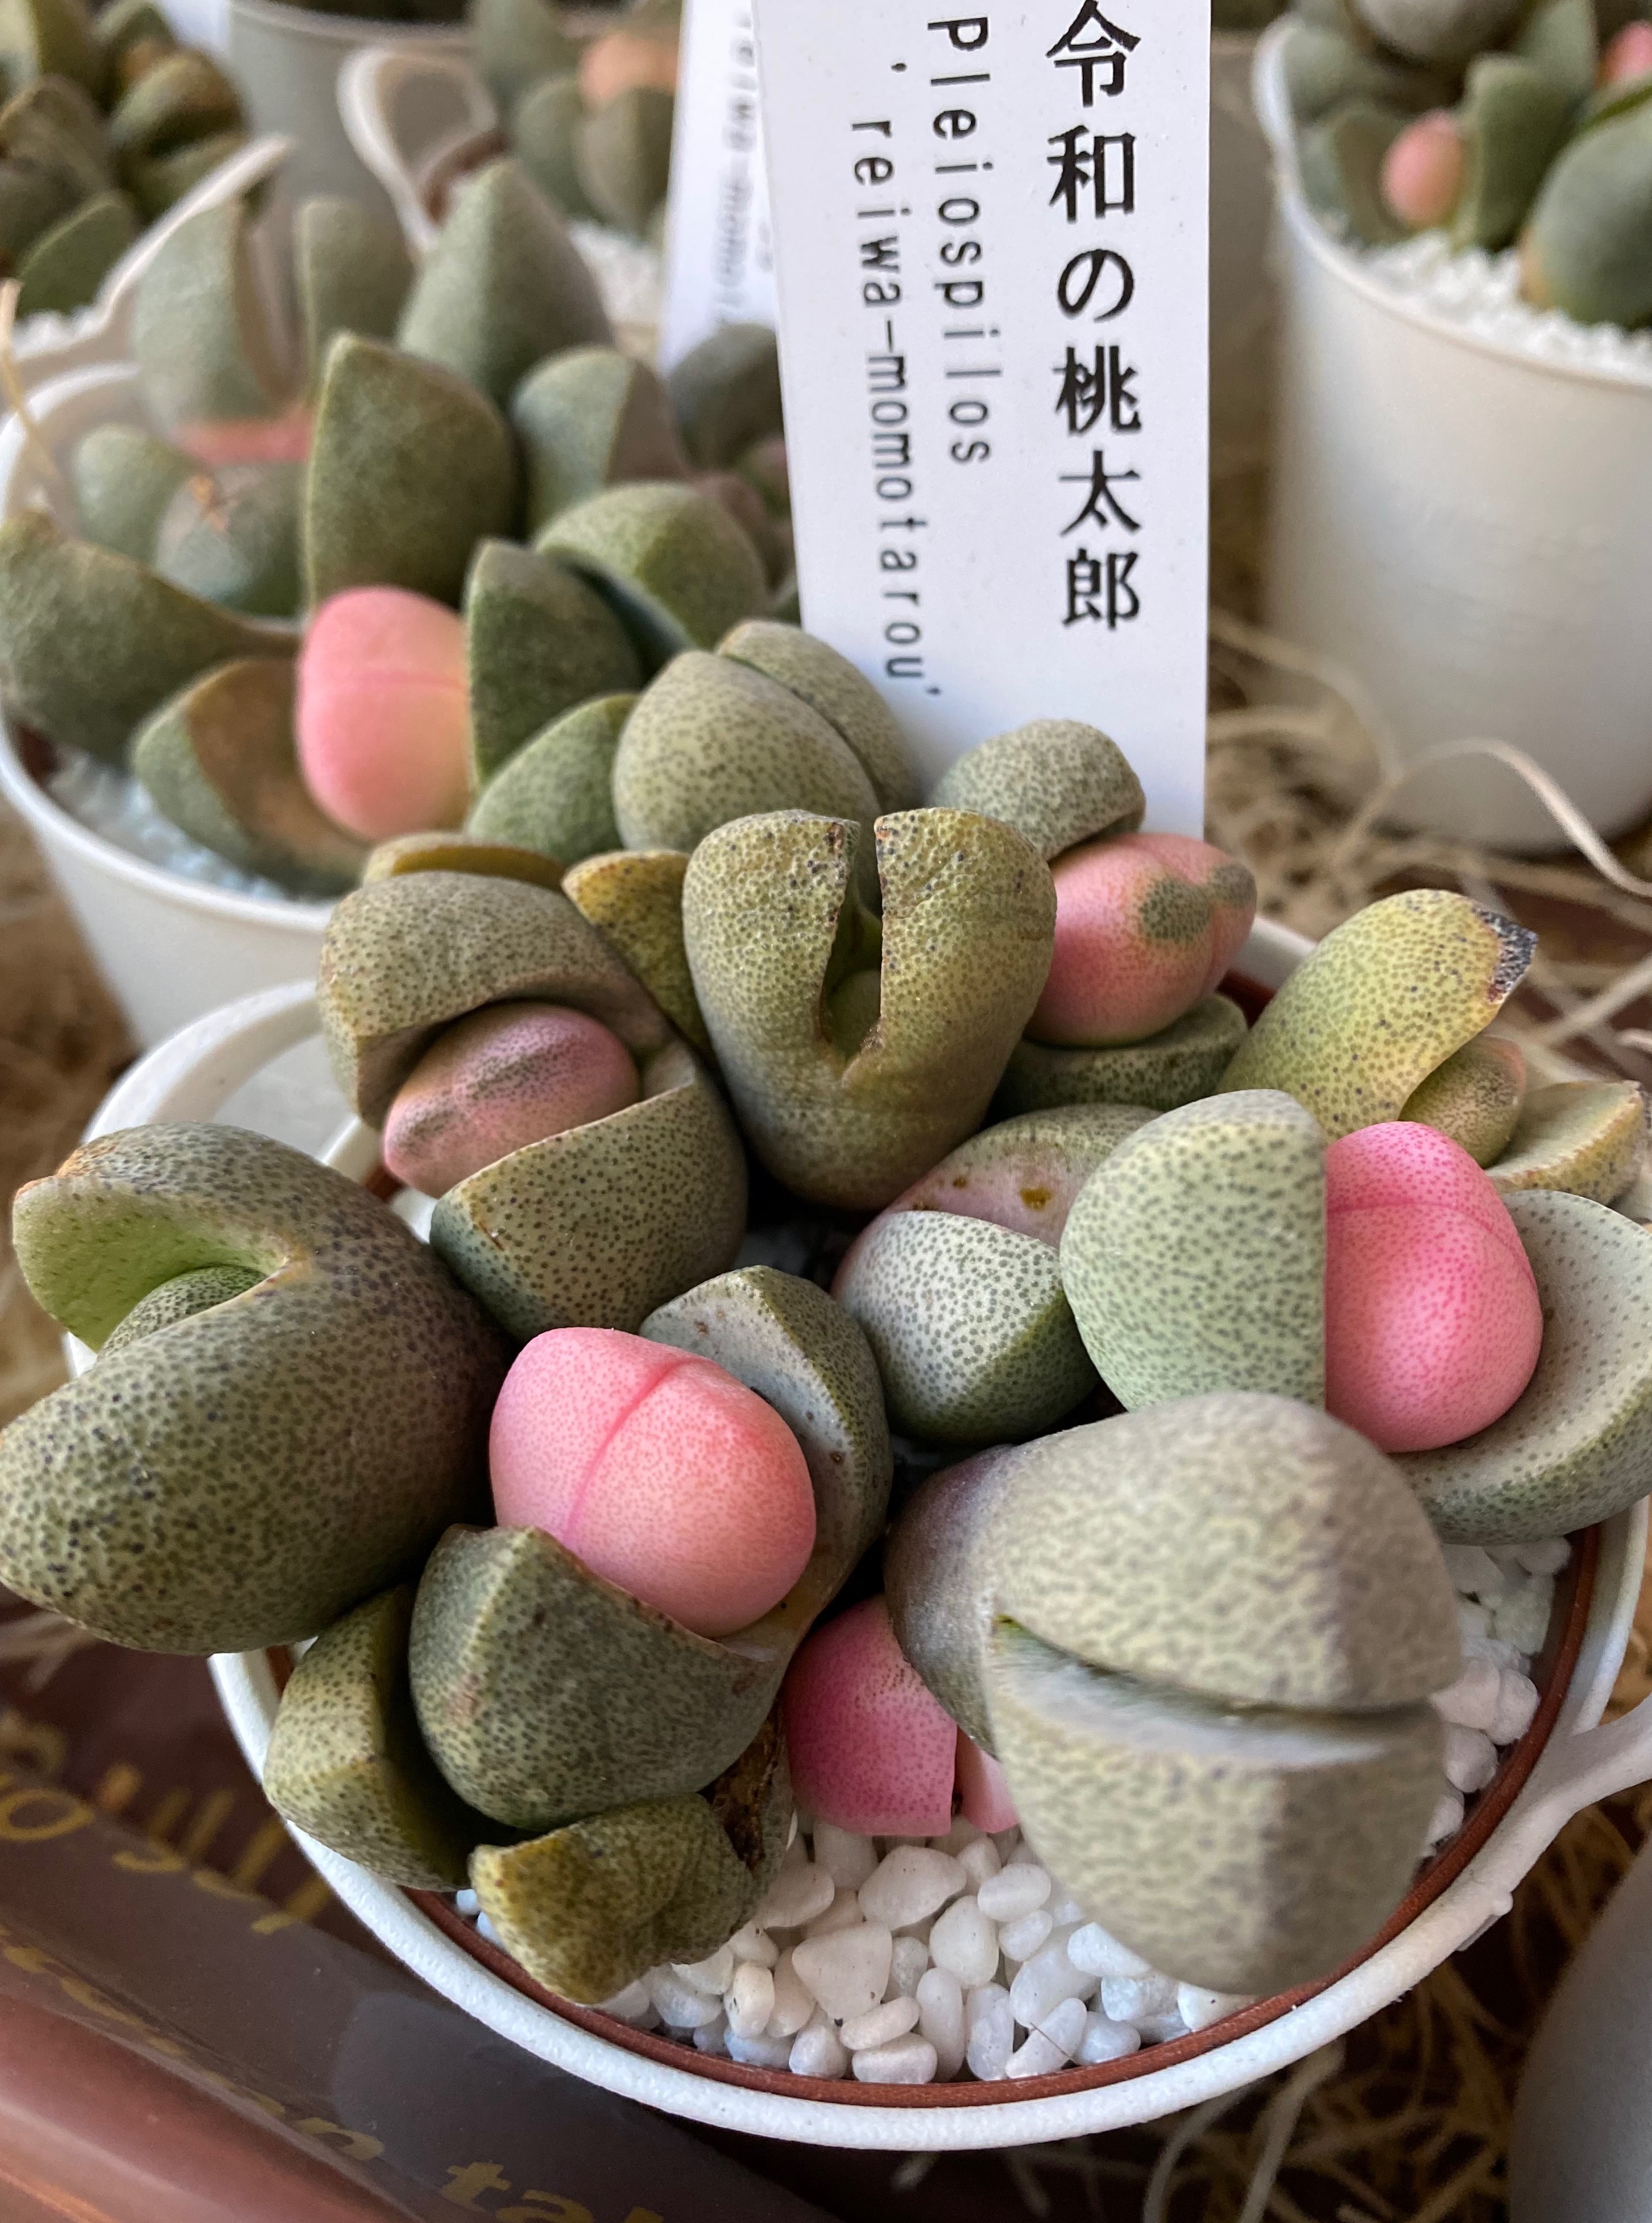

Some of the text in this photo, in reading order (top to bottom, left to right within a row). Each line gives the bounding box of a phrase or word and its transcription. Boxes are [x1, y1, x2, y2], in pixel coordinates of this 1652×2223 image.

[927, 16, 1003, 465] Pleiospilos
[1045, 0, 1142, 631] 令和の桃太郎
